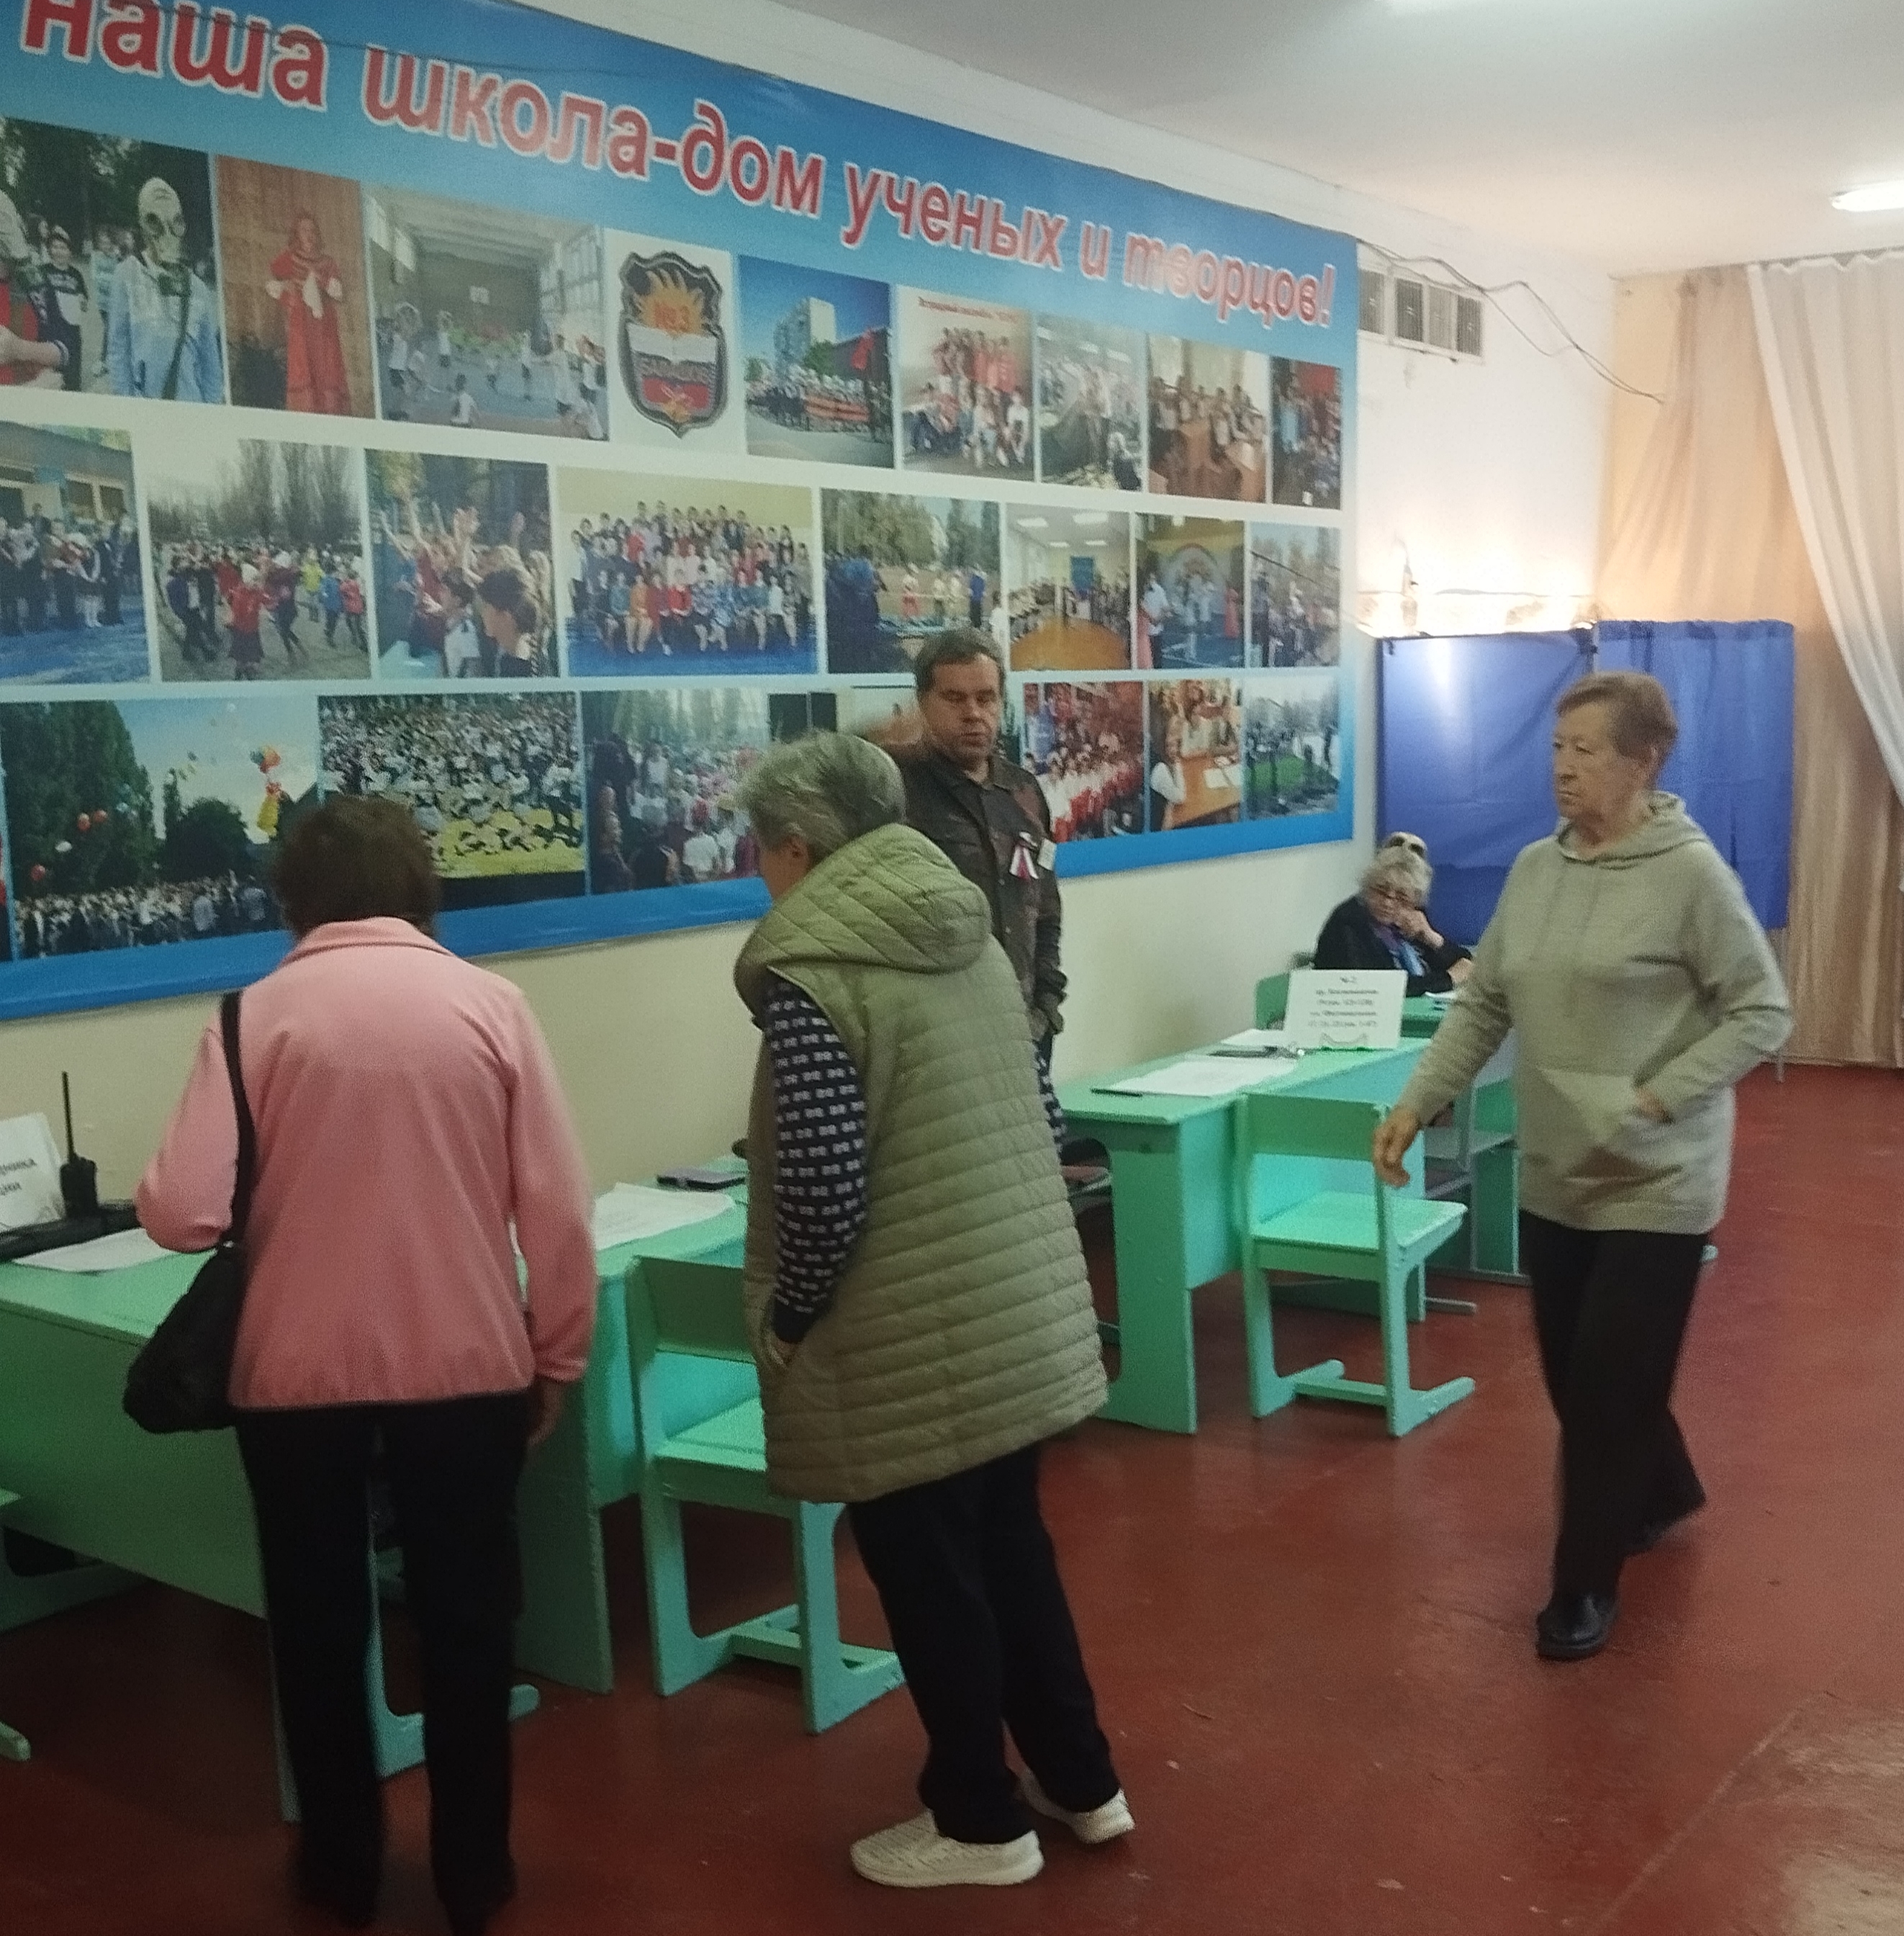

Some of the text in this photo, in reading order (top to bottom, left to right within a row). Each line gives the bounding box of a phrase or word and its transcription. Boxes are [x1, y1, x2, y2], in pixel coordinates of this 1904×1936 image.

[364, 45, 826, 217] школа-дом
[839, 161, 1068, 271] ученых
[1080, 220, 1111, 280] и
[1122, 230, 1336, 328] творцов!
